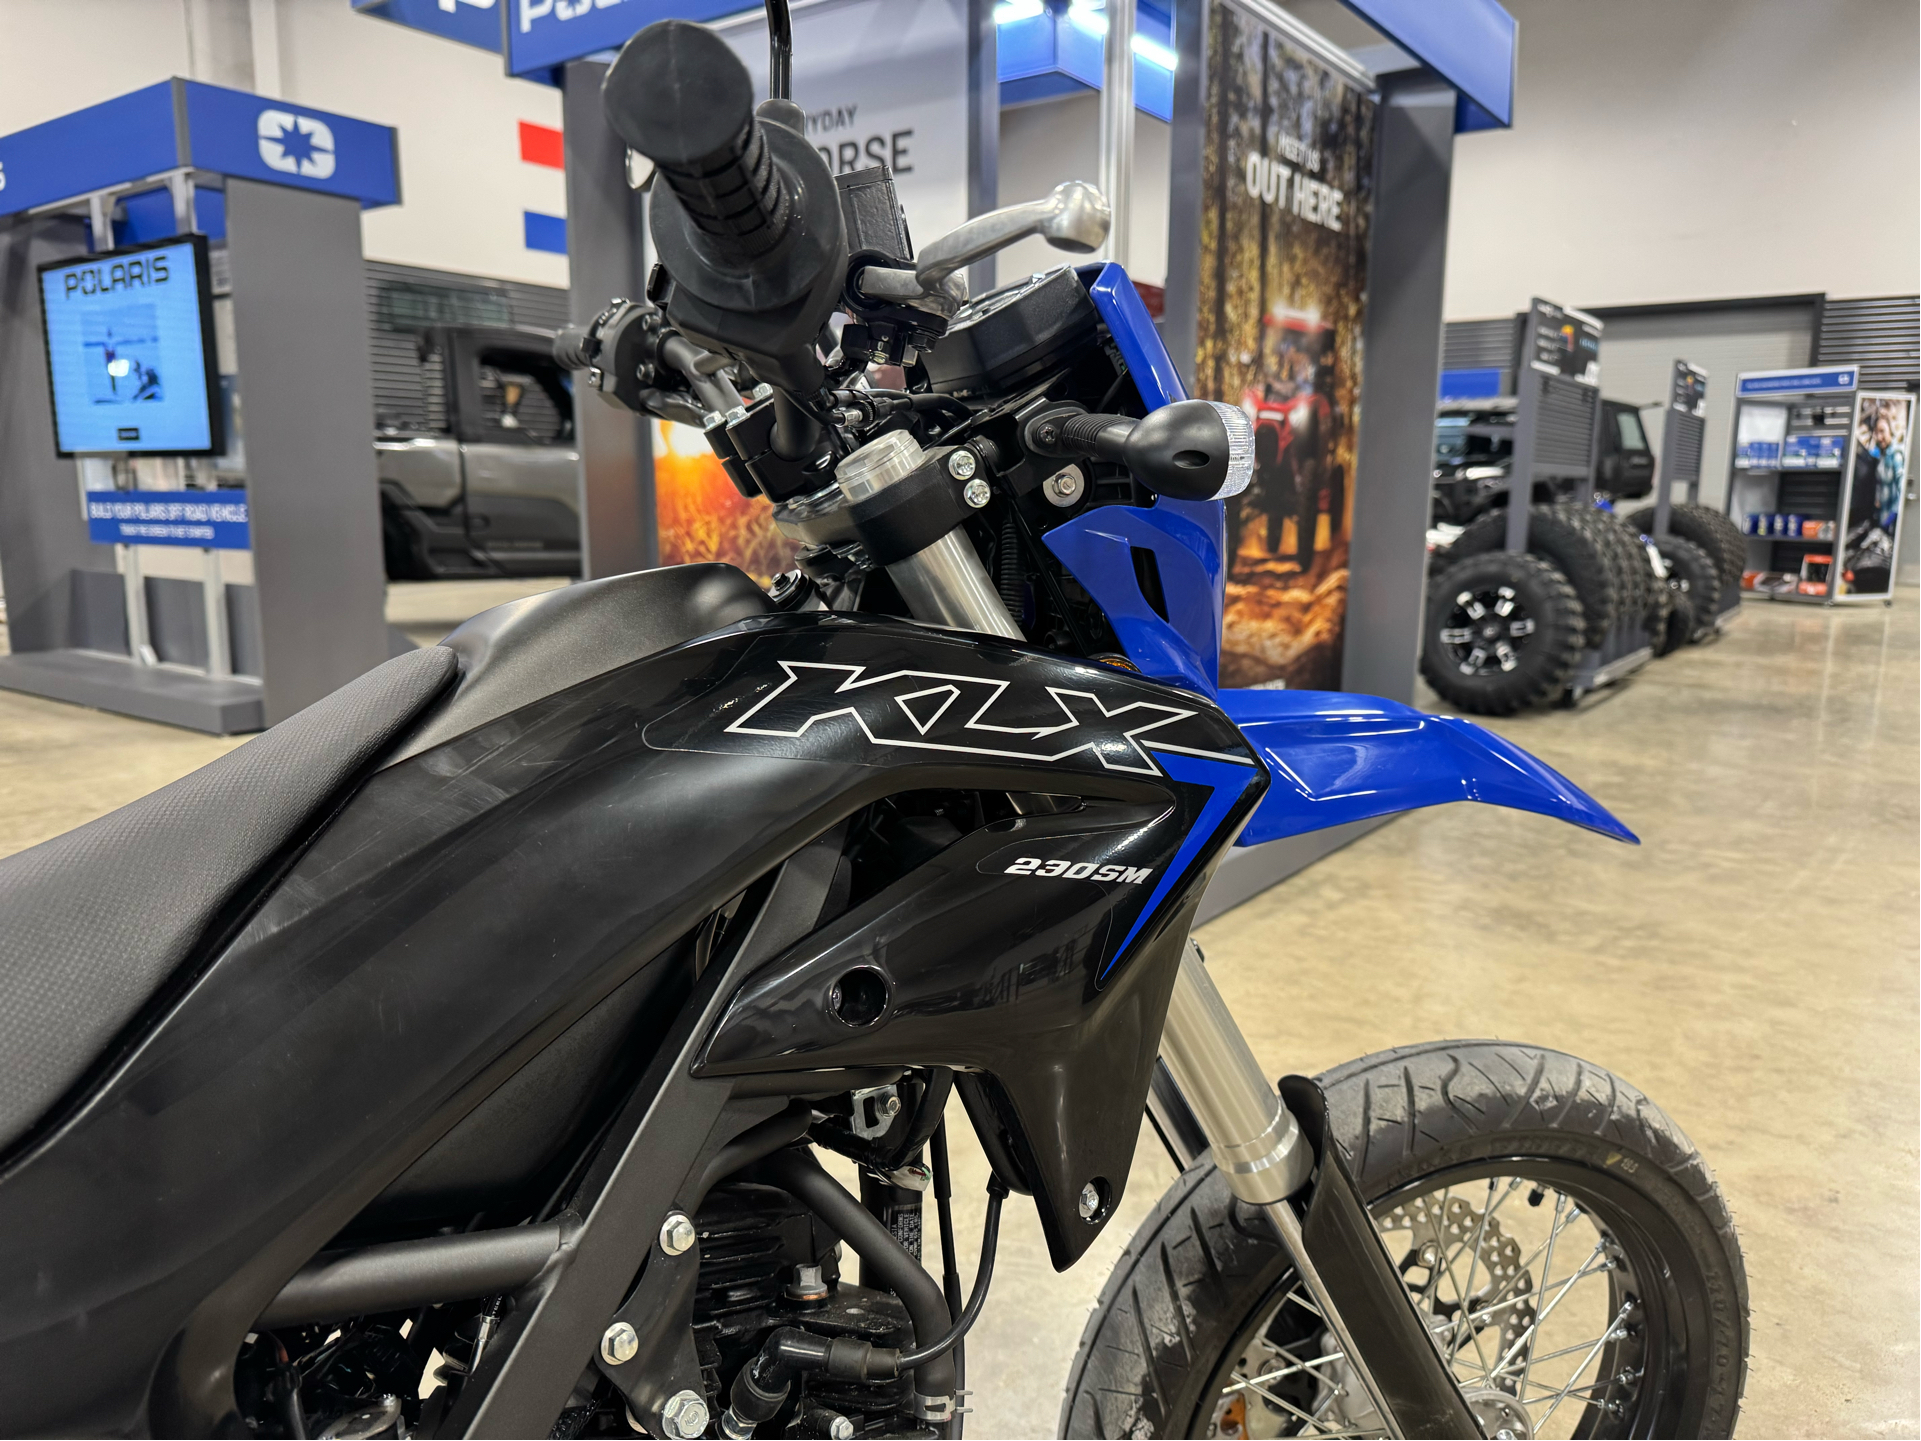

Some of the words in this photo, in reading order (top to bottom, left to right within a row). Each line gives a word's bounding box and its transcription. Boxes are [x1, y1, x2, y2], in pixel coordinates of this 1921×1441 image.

[1246, 151, 1292, 210] OUT
[1292, 172, 1344, 232] HERE
[64, 255, 169, 299] POLARIS
[725, 660, 1200, 777] KLX
[1003, 857, 1154, 885] 230SM
